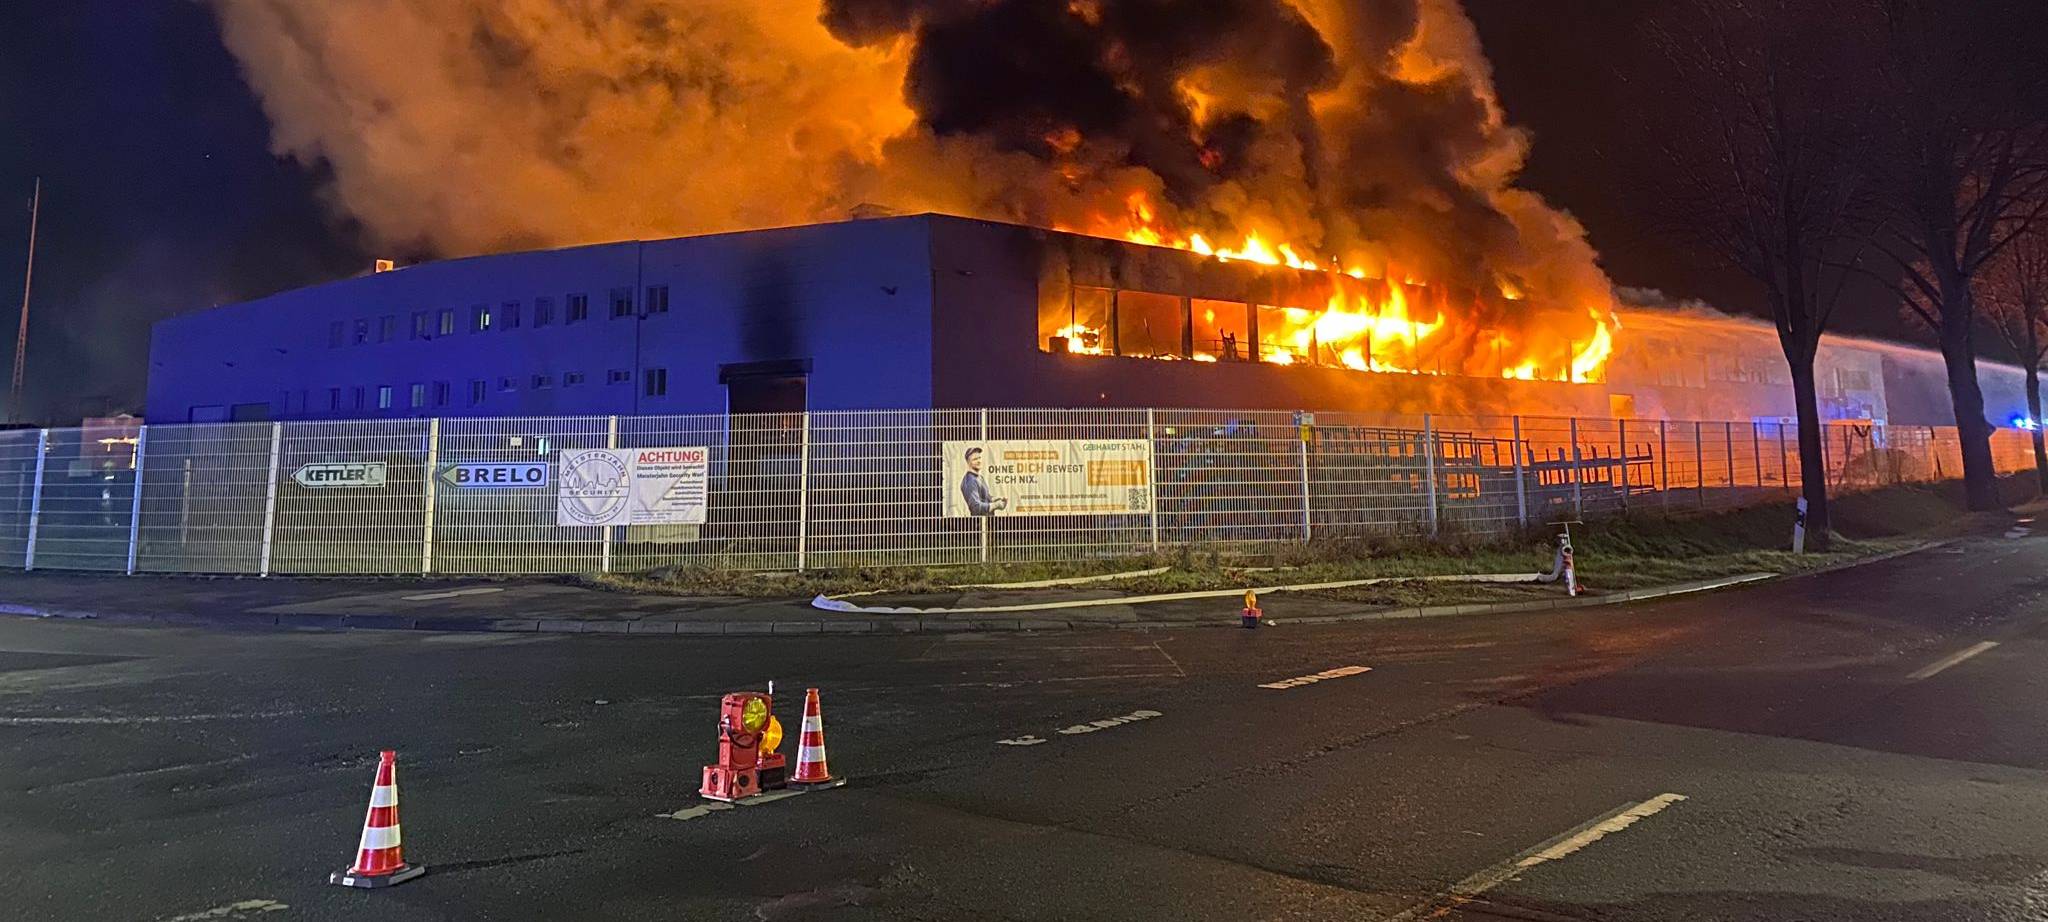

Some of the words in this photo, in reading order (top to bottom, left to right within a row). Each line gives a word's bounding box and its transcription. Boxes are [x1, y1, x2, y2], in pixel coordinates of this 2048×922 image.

[638, 450, 704, 462] ACHTUNG!
[565, 452, 626, 478] MEISTERJAHN
[988, 465, 1014, 474] OHNE
[1016, 462, 1044, 474] DICH
[1046, 464, 1084, 474] BEWEGT
[305, 469, 365, 481] KETTLER
[455, 467, 543, 484] BRELO
[995, 475, 1017, 484] SICH
[1019, 475, 1038, 484] NIX.
